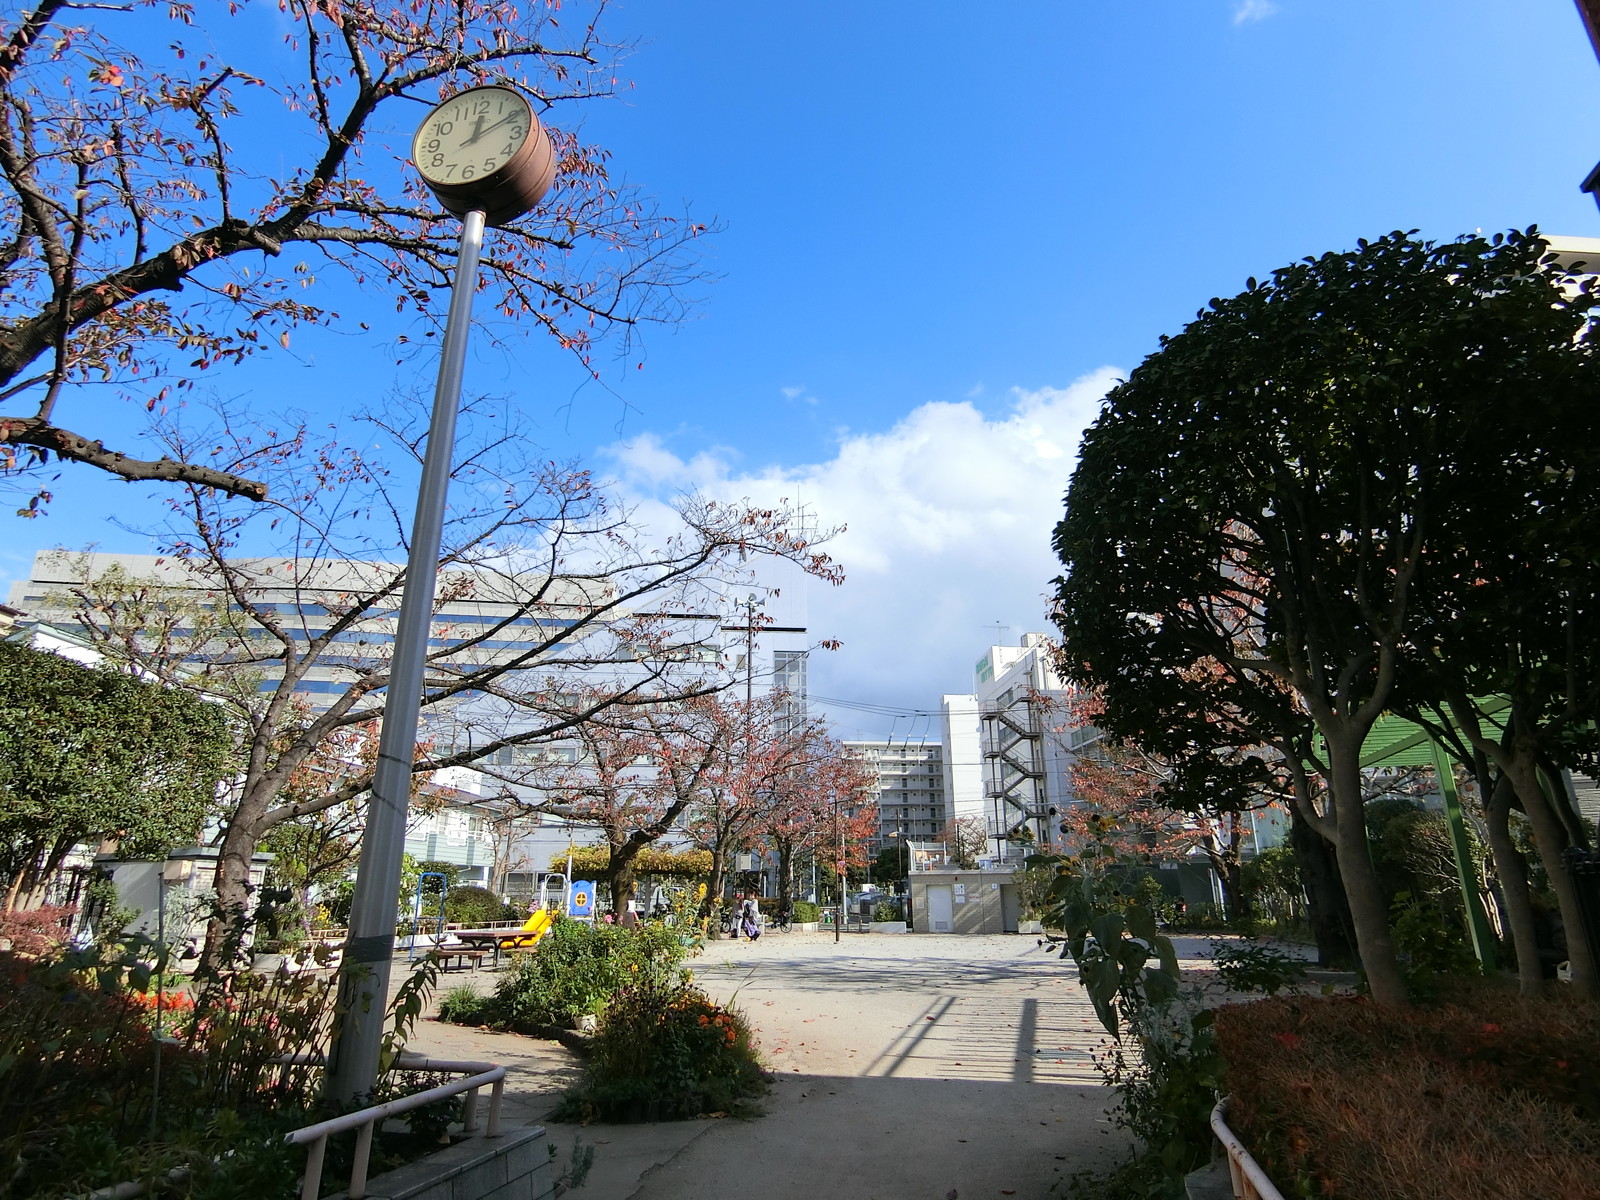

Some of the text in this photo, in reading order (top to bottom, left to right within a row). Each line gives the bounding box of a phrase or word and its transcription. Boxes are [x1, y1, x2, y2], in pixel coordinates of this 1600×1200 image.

[455, 107, 469, 121] 11
[473, 100, 491, 115] 12
[498, 101, 504, 114] 1
[506, 110, 518, 124] 2
[436, 122, 453, 136] 10
[509, 125, 522, 140] 3
[428, 139, 440, 153] 9
[500, 143, 513, 156] 4
[431, 153, 444, 167] 8
[483, 158, 496, 172] 5
[445, 164, 458, 178] 7
[462, 165, 475, 179] 6
